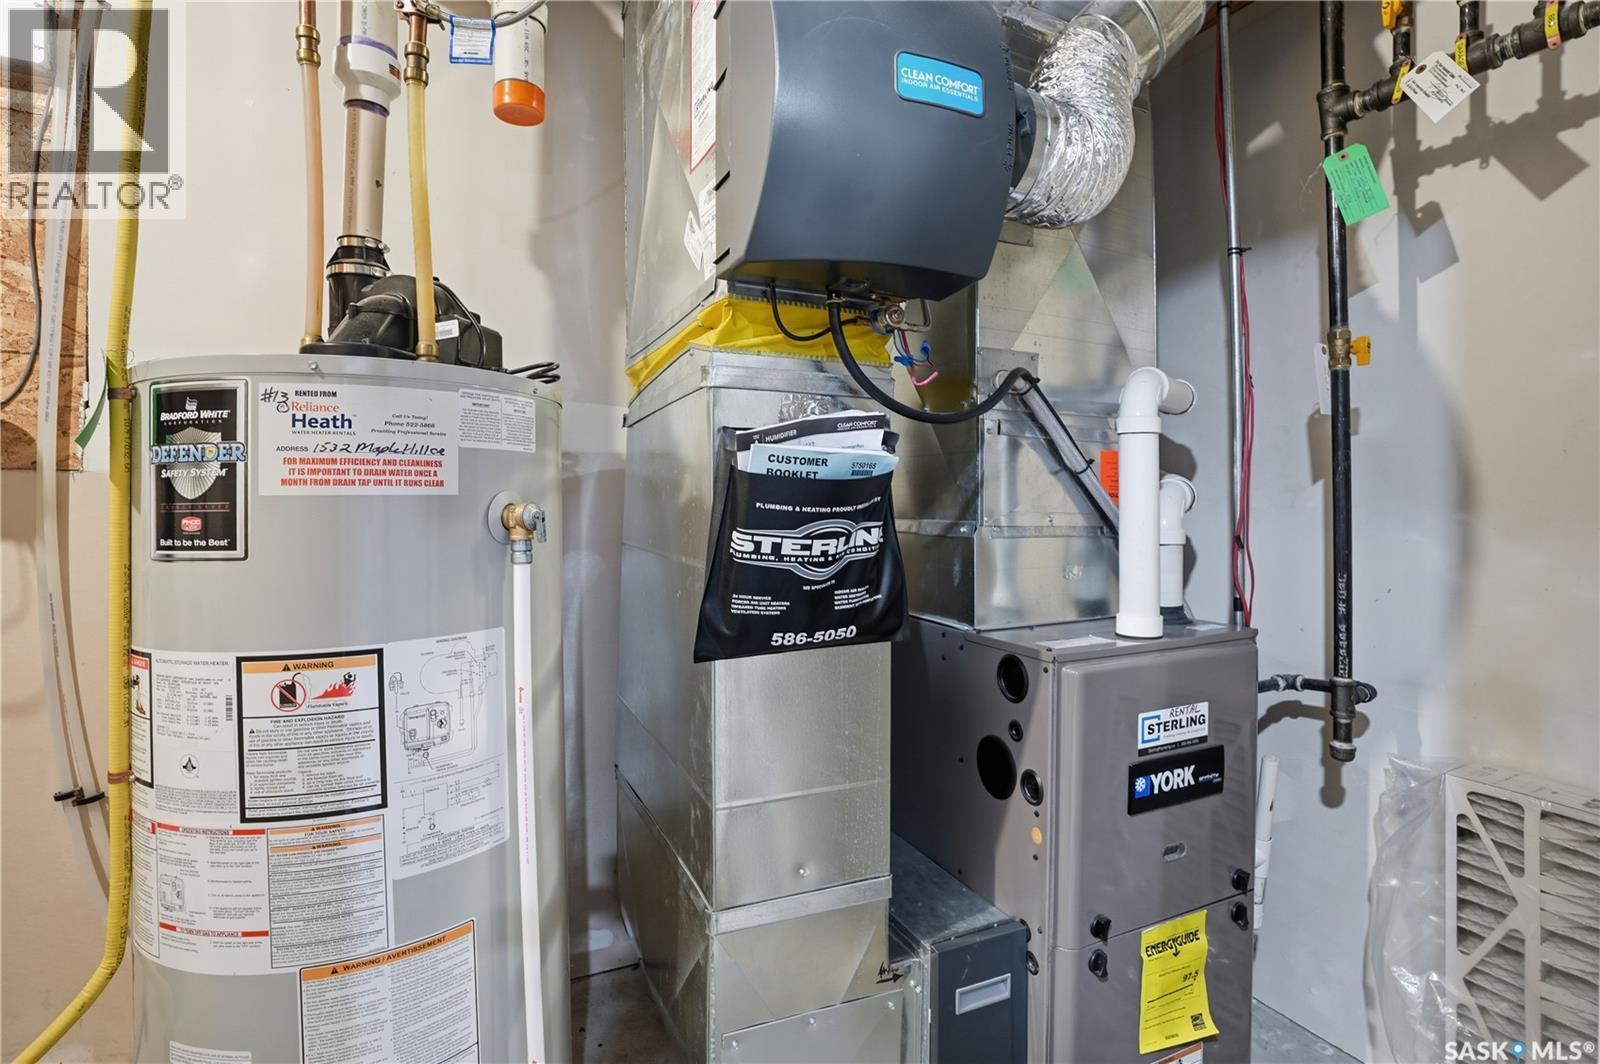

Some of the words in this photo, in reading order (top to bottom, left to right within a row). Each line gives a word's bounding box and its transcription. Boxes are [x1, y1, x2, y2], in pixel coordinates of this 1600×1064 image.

[901, 67, 933, 82] CLEAN
[934, 74, 978, 95] COMFORT
[901, 78, 928, 89] INDOOR
[929, 83, 941, 91] AIR
[294, 390, 319, 398] RENTED
[291, 401, 340, 413] Reliance
[160, 411, 198, 422] BRADFORD
[200, 409, 230, 419] WHITE
[291, 413, 353, 430] Heath
[765, 429, 798, 442] HUMIDIFIER
[151, 440, 248, 464] DEFENDER
[313, 441, 352, 454] 1532
[283, 457, 298, 466] FOR
[298, 457, 338, 466] MAXIMUM
[339, 458, 381, 467] EFFICIENCY
[382, 459, 397, 467] AND
[398, 459, 443, 468] CLEANLINESS
[767, 454, 829, 467] CUSTOMER
[160, 468, 189, 479] SAFETY
[190, 467, 228, 478] SYSTEM
[288, 468, 295, 476] IT
[296, 468, 305, 476] IS
[306, 468, 351, 477] IMPORTANT
[352, 468, 362, 477] TO
[363, 468, 387, 477] DRAIN
[388, 469, 413, 477] WATER
[413, 469, 433, 478] ONCE
[432, 469, 438, 478] A
[280, 478, 308, 487] MONTH
[309, 478, 331, 487] FROM
[332, 478, 356, 487] DRAIN
[357, 479, 372, 487] TAP
[372, 479, 394, 488] UNTIL
[394, 479, 402, 488] IT
[403, 479, 423, 488] RUNS
[423, 480, 445, 488] CLEAR
[755, 502, 794, 512] PLUMBING
[174, 538, 182, 546] to
[183, 538, 192, 546] be
[193, 538, 207, 546] the
[208, 538, 228, 547] Best
[783, 556, 826, 564] HEATING
[769, 625, 857, 647] 586-5050
[292, 661, 335, 671] WARNING
[1169, 703, 1201, 719] RENTAL
[1147, 714, 1206, 735] STERLING
[1150, 764, 1196, 794] YORK
[342, 957, 382, 972] WARNING
[386, 935, 447, 961] AVERTISSEMENT
